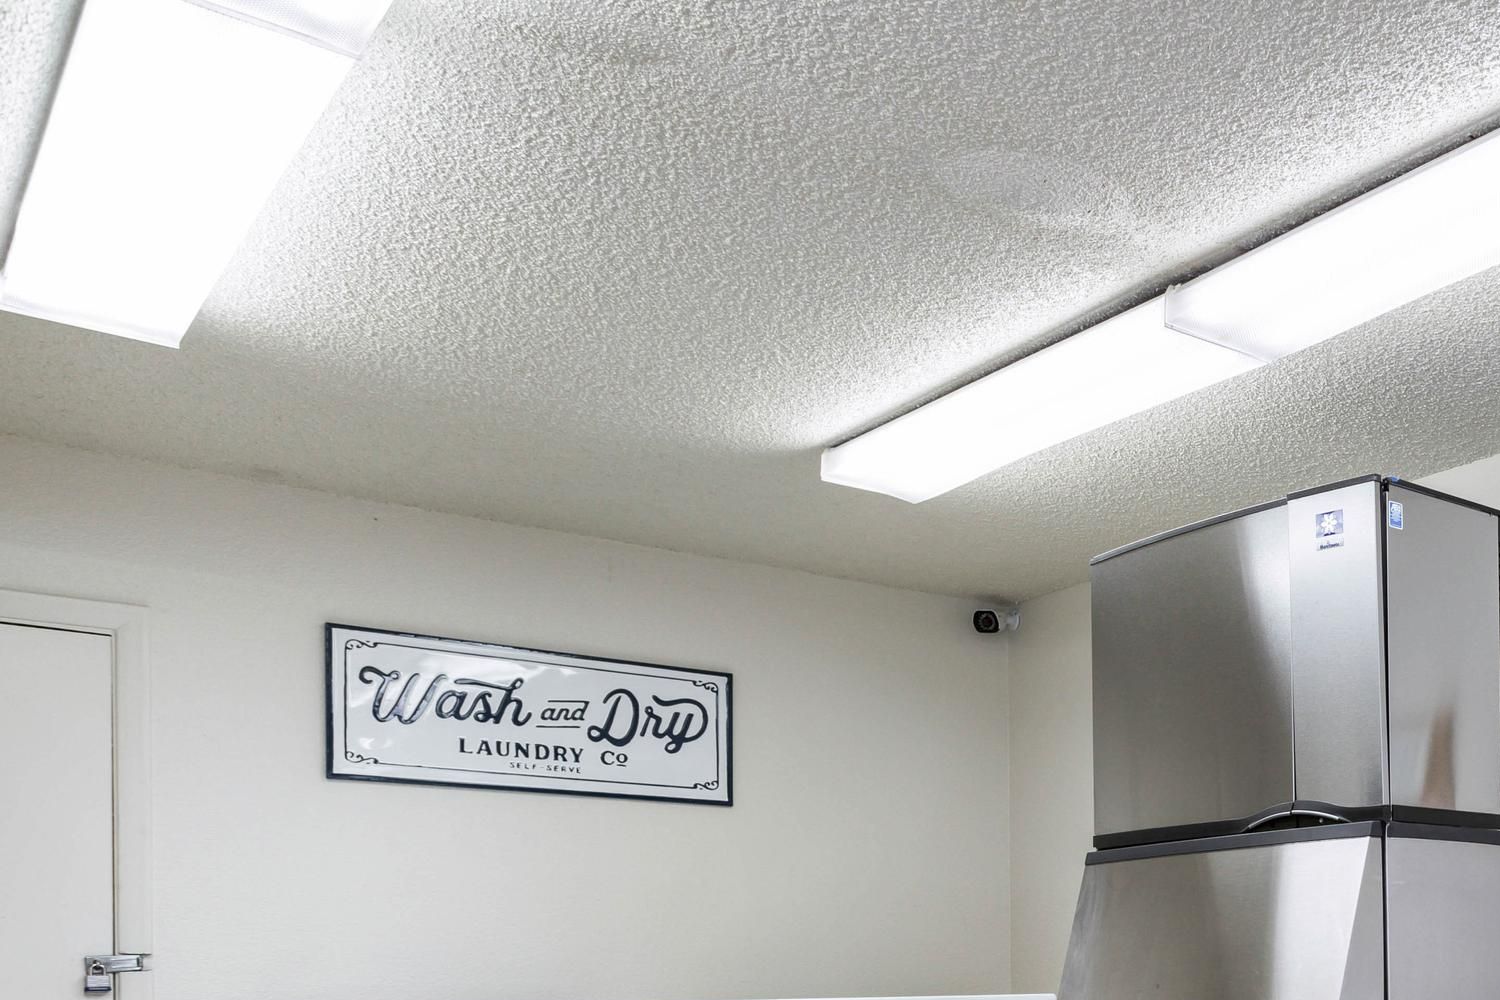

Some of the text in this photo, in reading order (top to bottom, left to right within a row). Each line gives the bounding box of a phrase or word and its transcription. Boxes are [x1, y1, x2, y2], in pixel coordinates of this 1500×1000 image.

[359, 666, 709, 754] Wash and Dry
[458, 737, 584, 764] LAUNDRY
